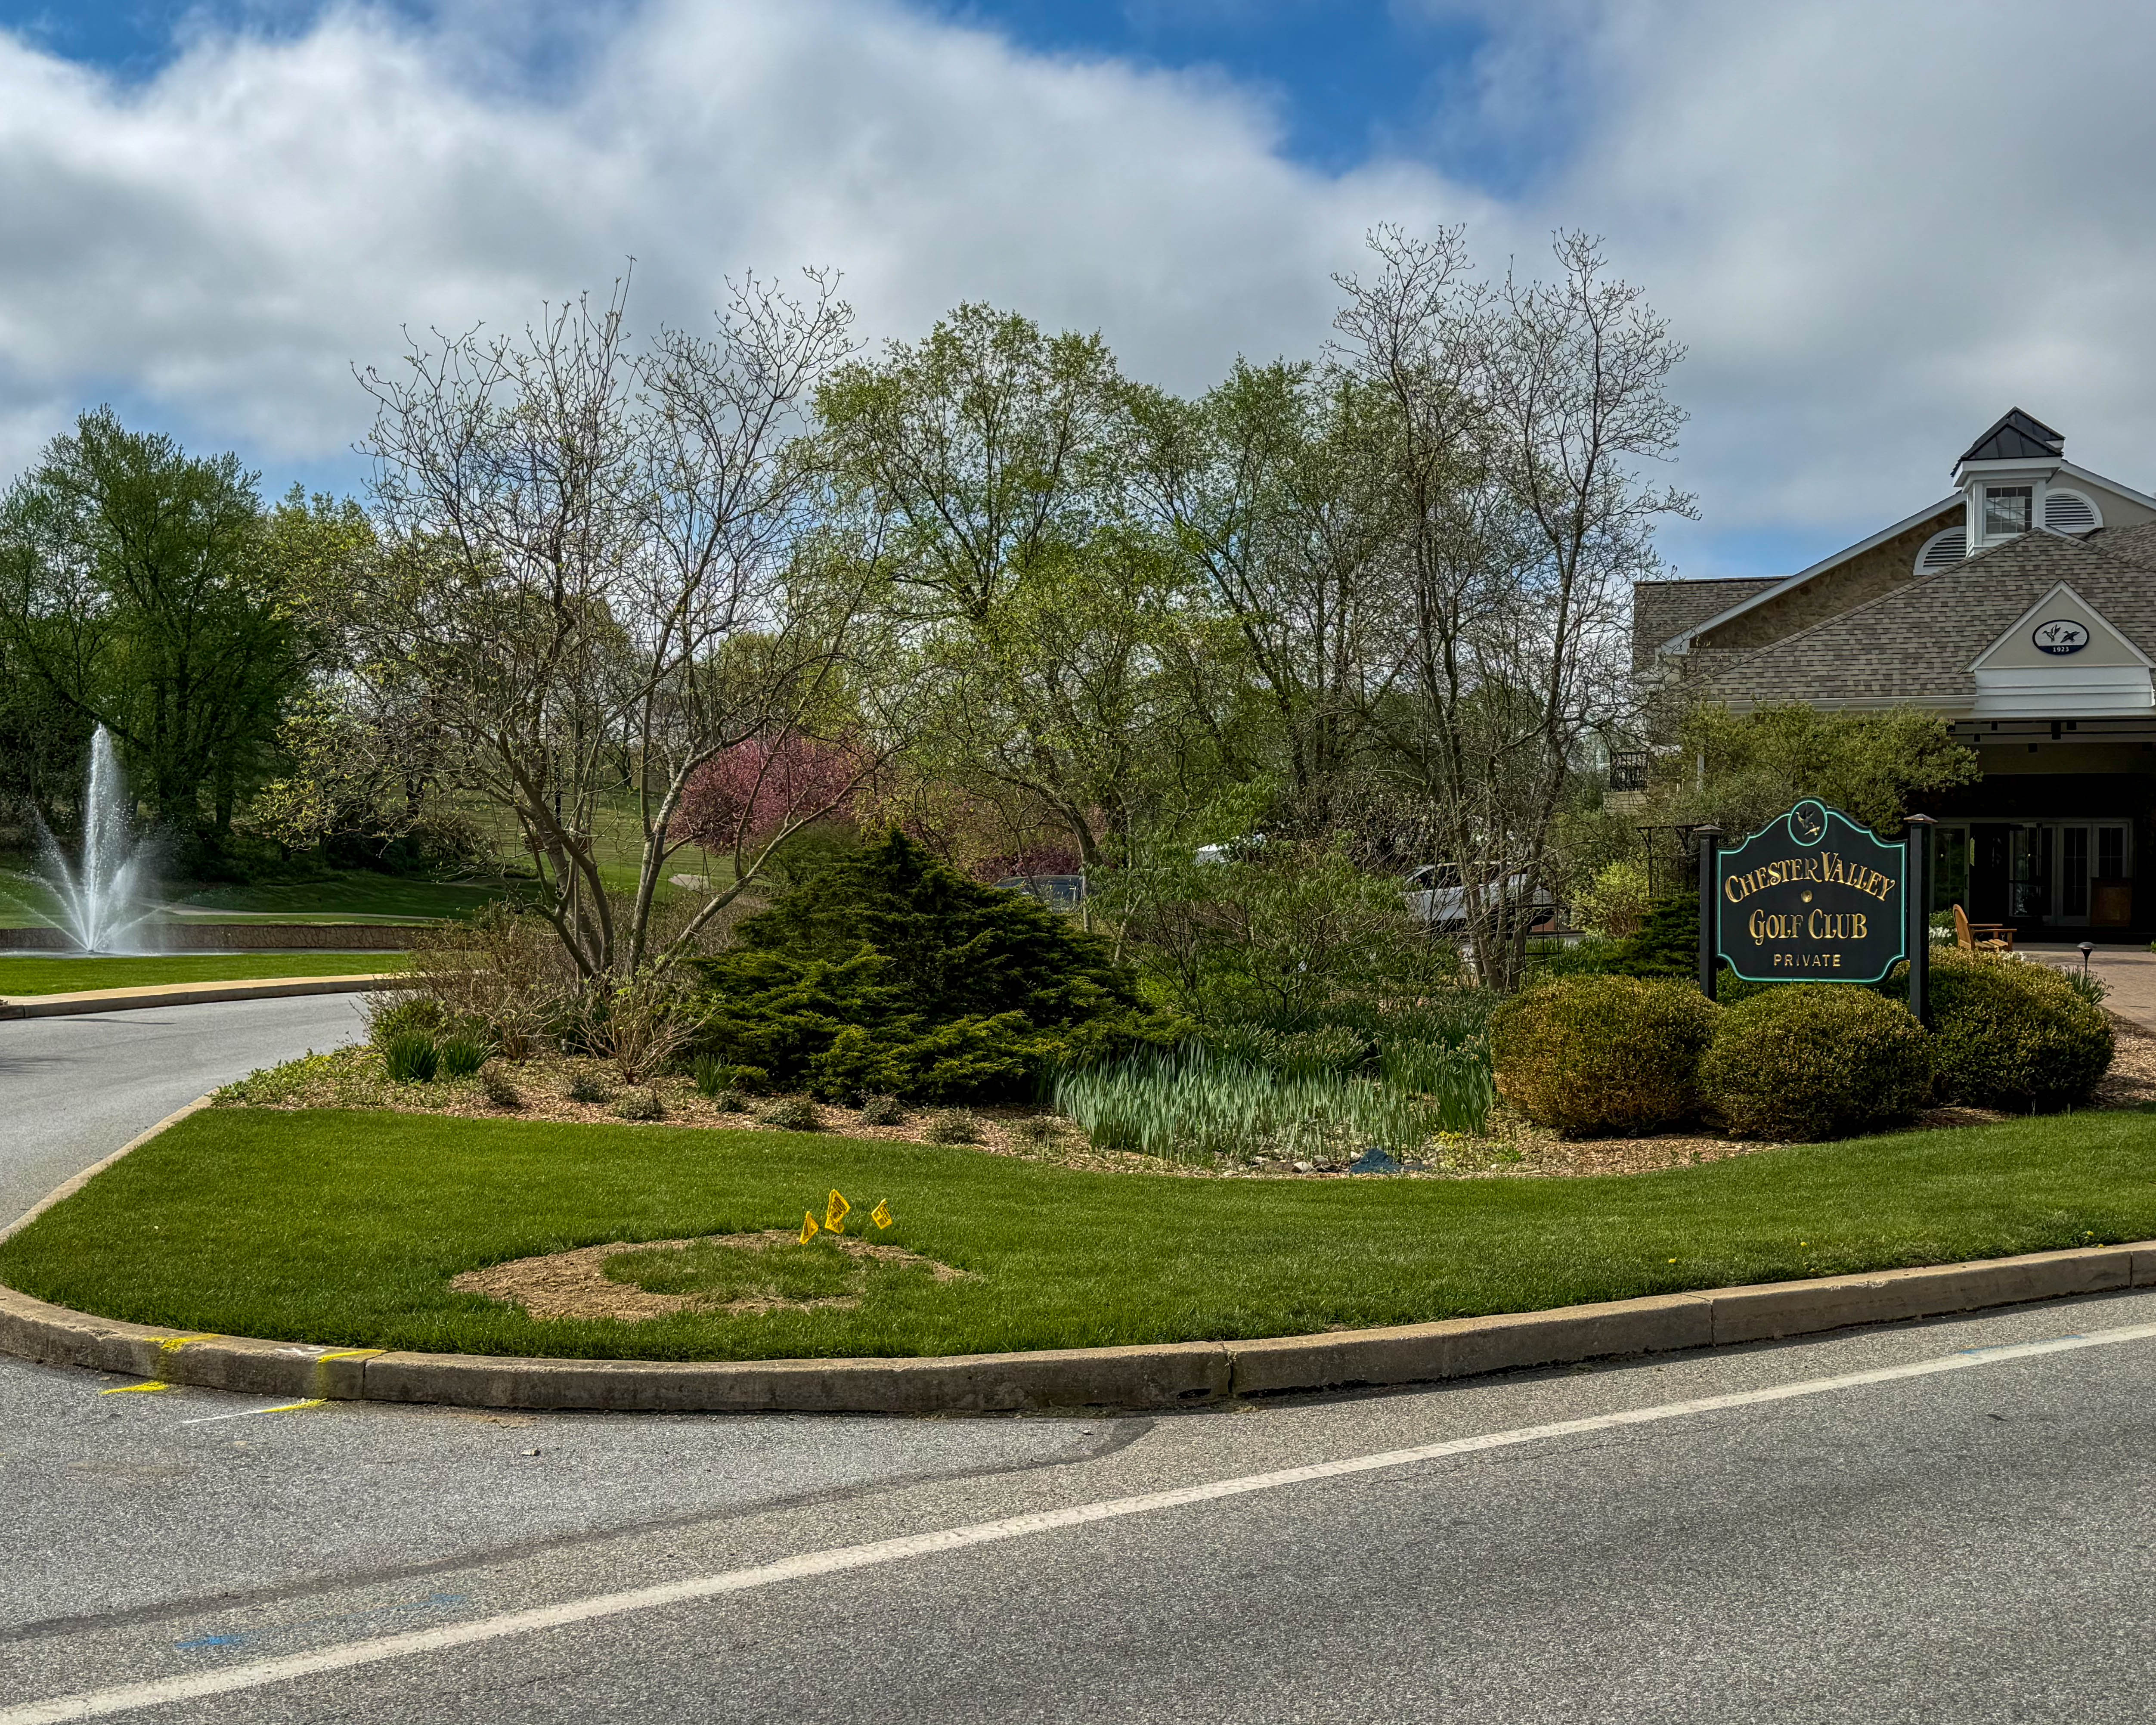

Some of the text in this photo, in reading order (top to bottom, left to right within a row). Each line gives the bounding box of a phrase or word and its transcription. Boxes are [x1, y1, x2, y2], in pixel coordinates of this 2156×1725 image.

[1725, 851, 1895, 903] CHESTER VALLEY
[1749, 909, 1868, 946] GOLF CLUB
[1774, 953, 1841, 966] PRIVATE
